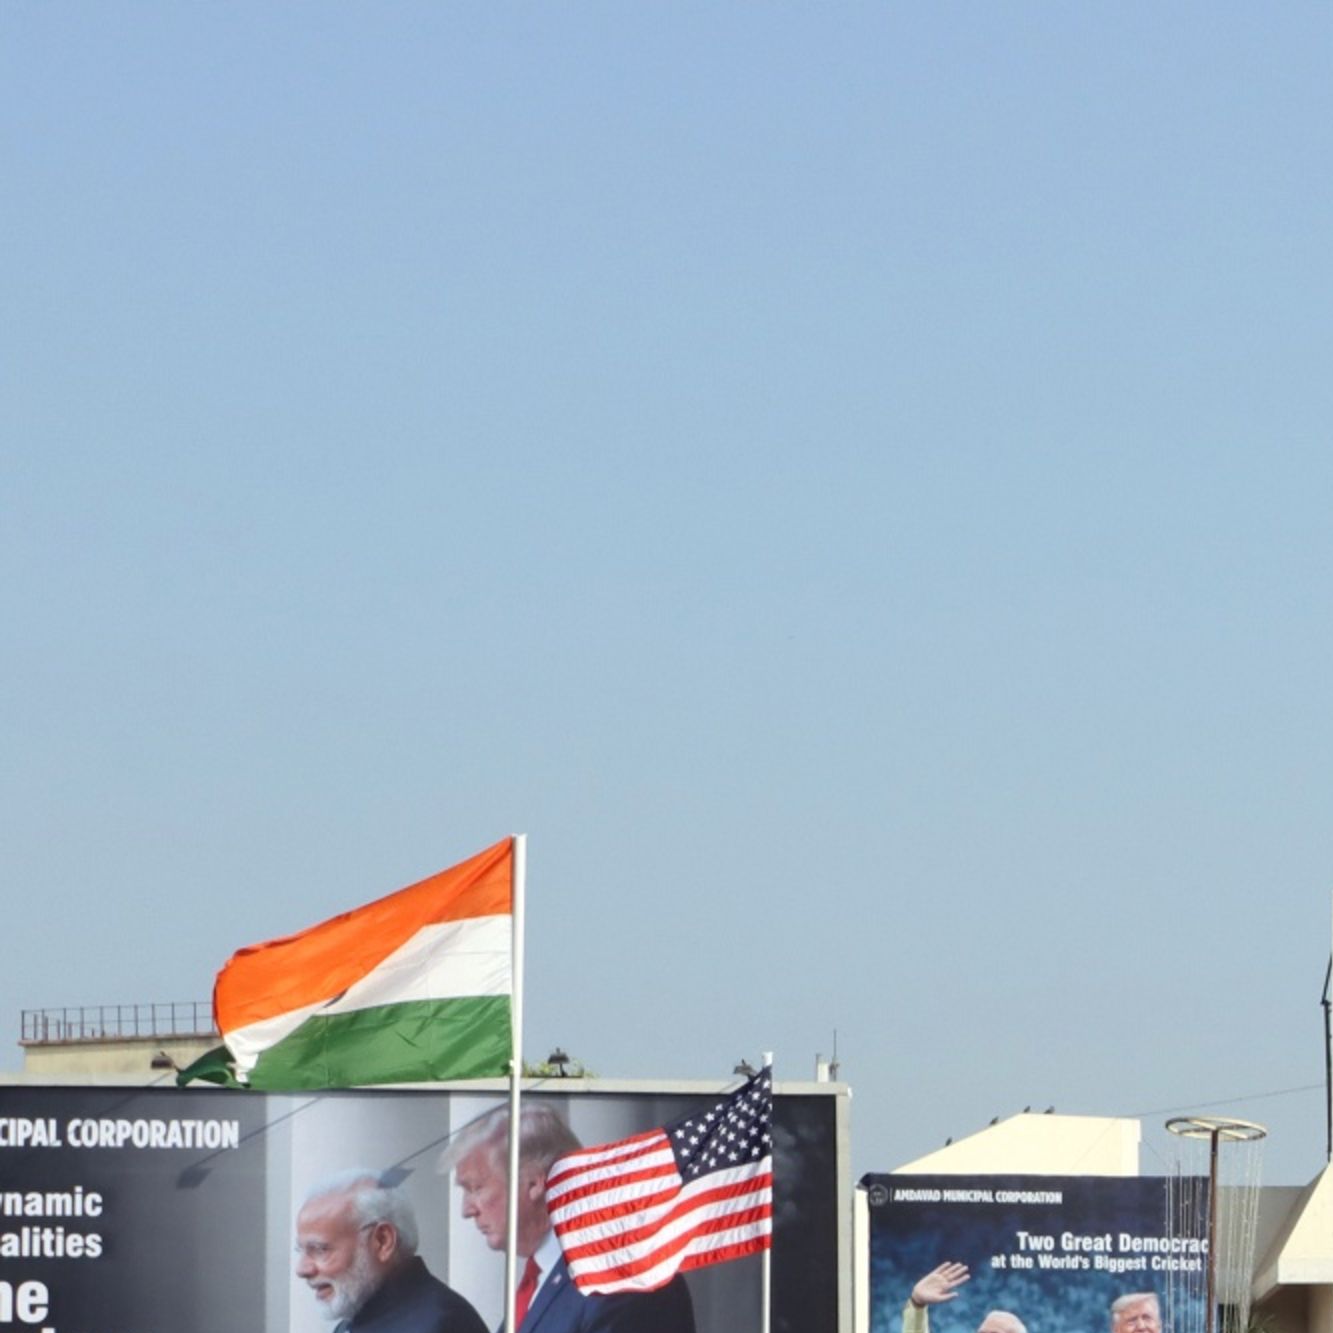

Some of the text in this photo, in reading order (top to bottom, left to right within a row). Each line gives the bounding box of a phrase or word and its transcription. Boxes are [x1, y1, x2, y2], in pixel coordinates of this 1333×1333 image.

[67, 1119, 239, 1149] CORPORATION
[0, 1186, 103, 1217] namic
[1016, 1231, 1055, 1251] Two
[1061, 1232, 1112, 1252] Great
[991, 1255, 1202, 1273] at the World's Biggest Cricket
